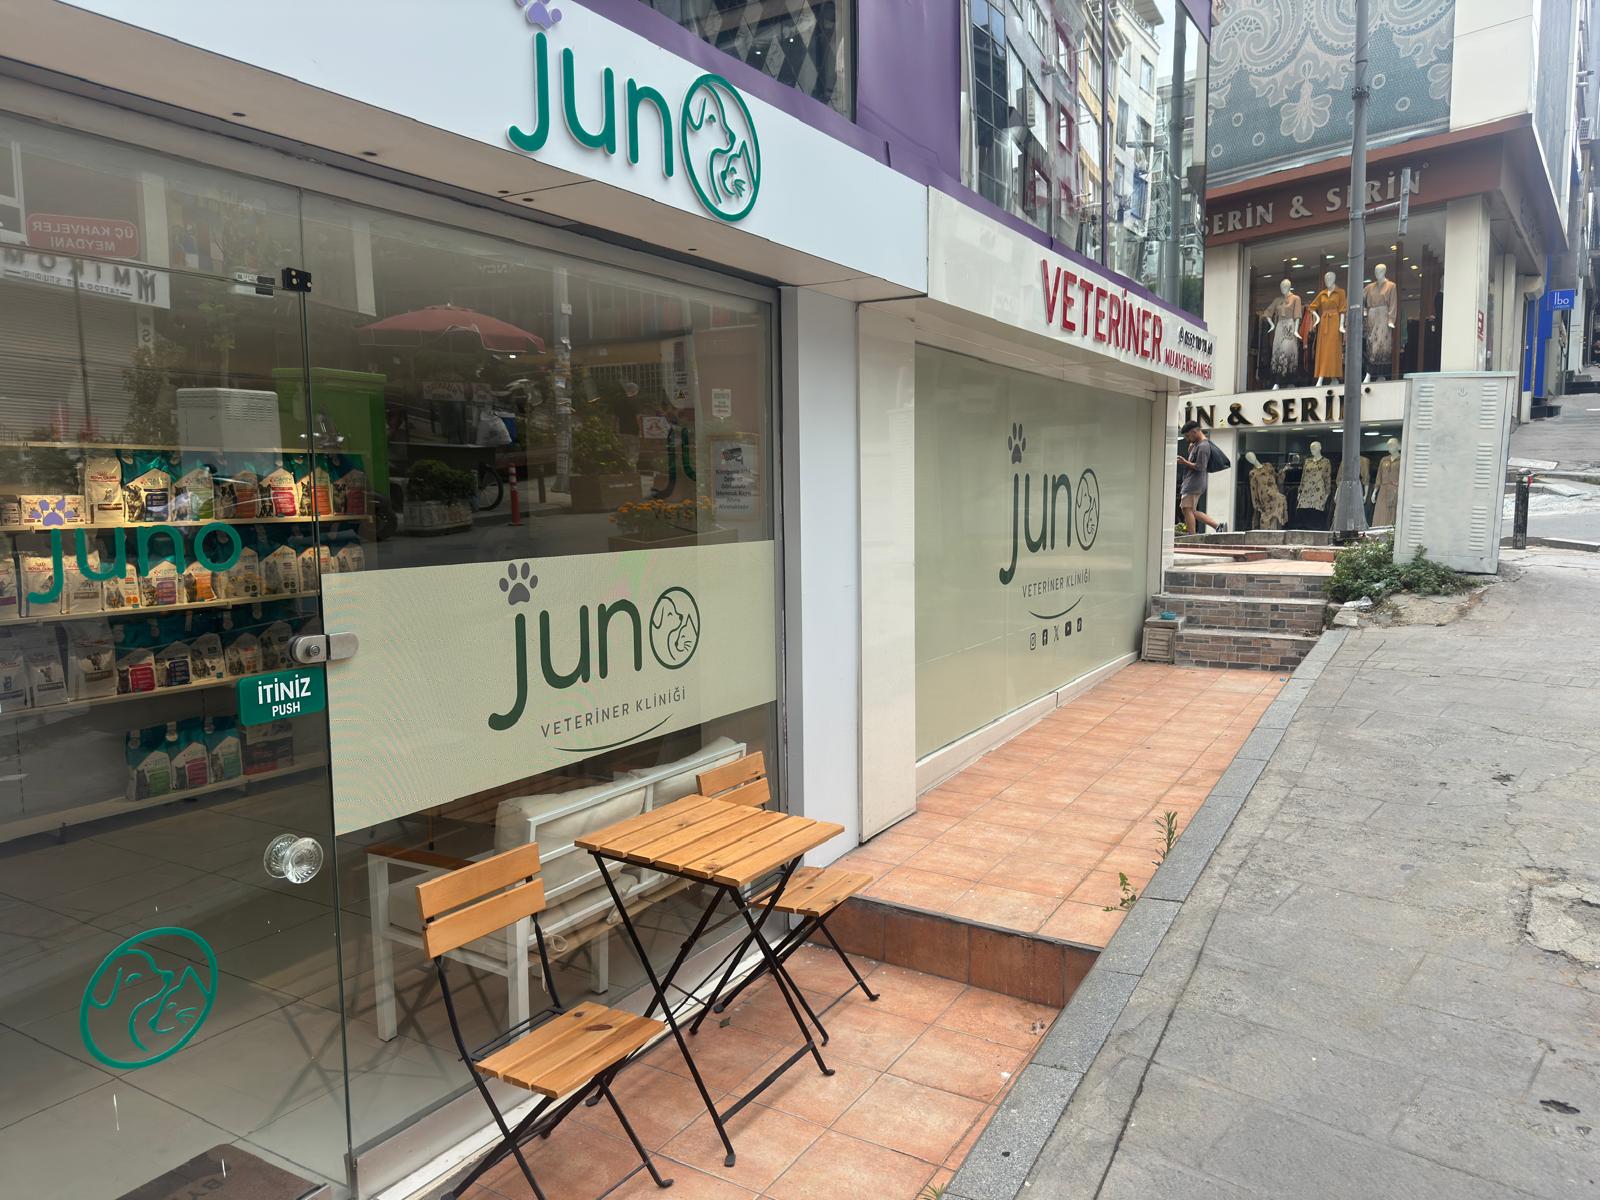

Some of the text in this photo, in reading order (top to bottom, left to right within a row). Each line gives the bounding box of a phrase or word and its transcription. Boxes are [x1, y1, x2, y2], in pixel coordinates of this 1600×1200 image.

[1289, 195, 1312, 218] &
[1326, 171, 1421, 211] SRİN
[1041, 259, 1163, 362] VETERİNER
[1227, 402, 1253, 426] &
[27, 522, 242, 604] juno
[1022, 568, 1091, 598] VETERİNER KLİNİĞİ
[257, 674, 311, 705] İTİNİZ
[272, 701, 301, 717] PUSH
[541, 686, 686, 738] VETERİNER KLİNİĞİ
